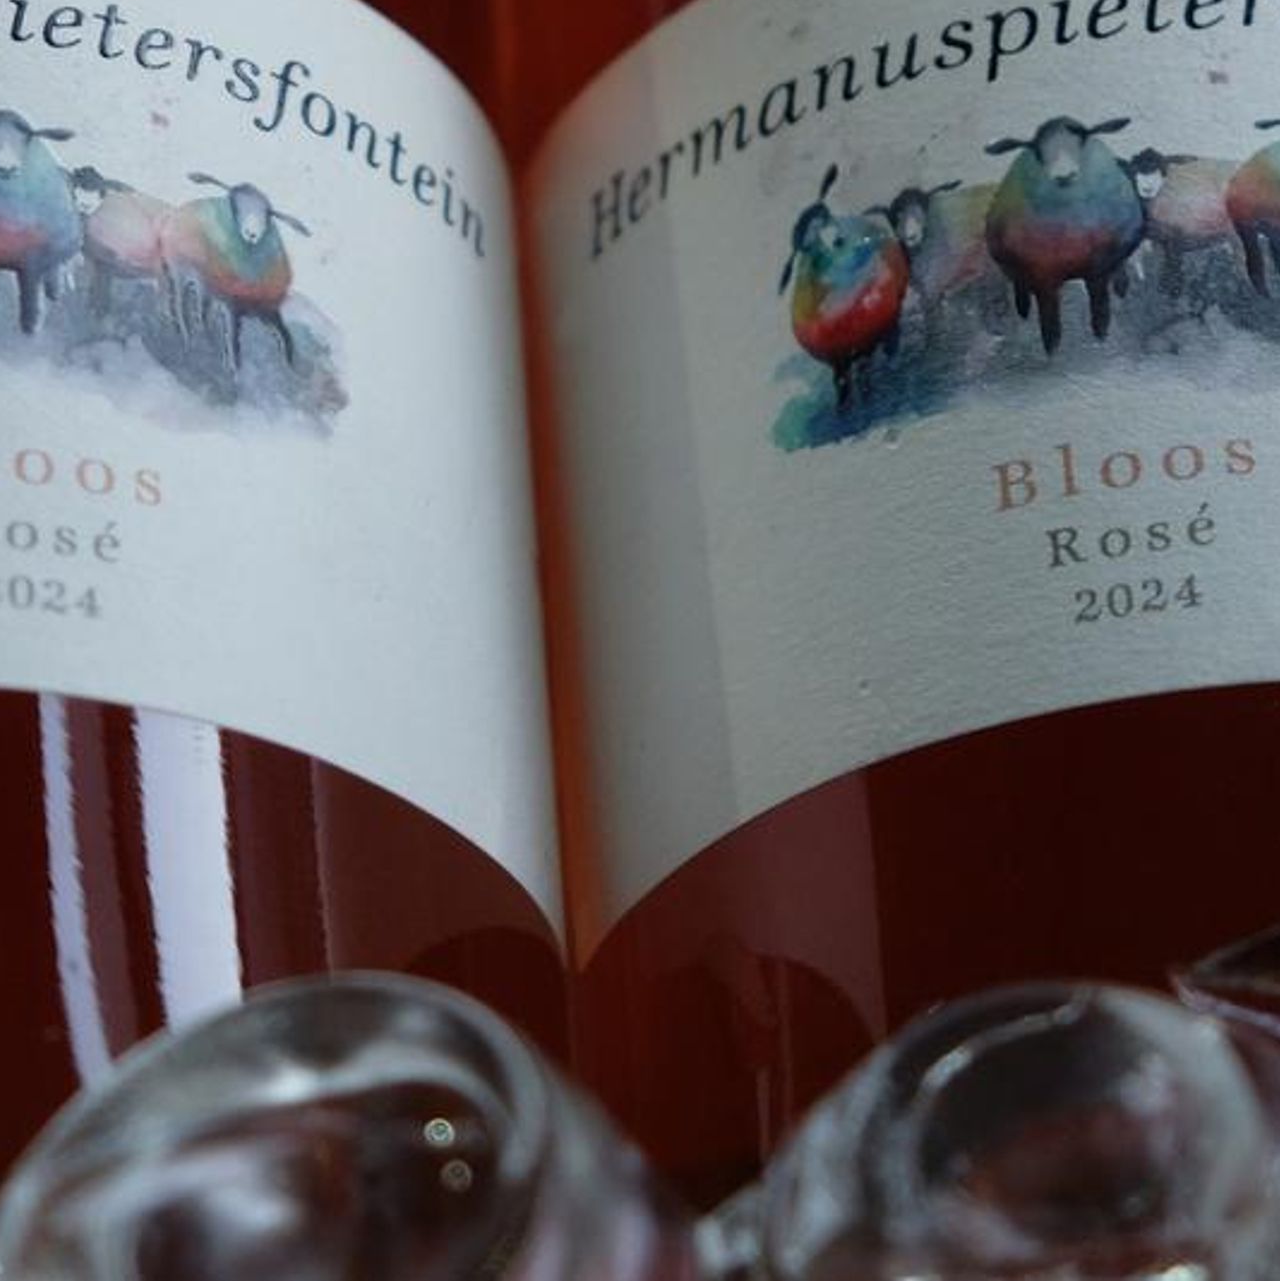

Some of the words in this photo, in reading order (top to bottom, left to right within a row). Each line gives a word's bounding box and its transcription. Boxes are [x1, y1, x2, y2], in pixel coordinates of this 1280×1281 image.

[992, 438, 1257, 513] Bloos
[1045, 502, 1216, 568] Rosé
[1075, 573, 1203, 624] 2024
